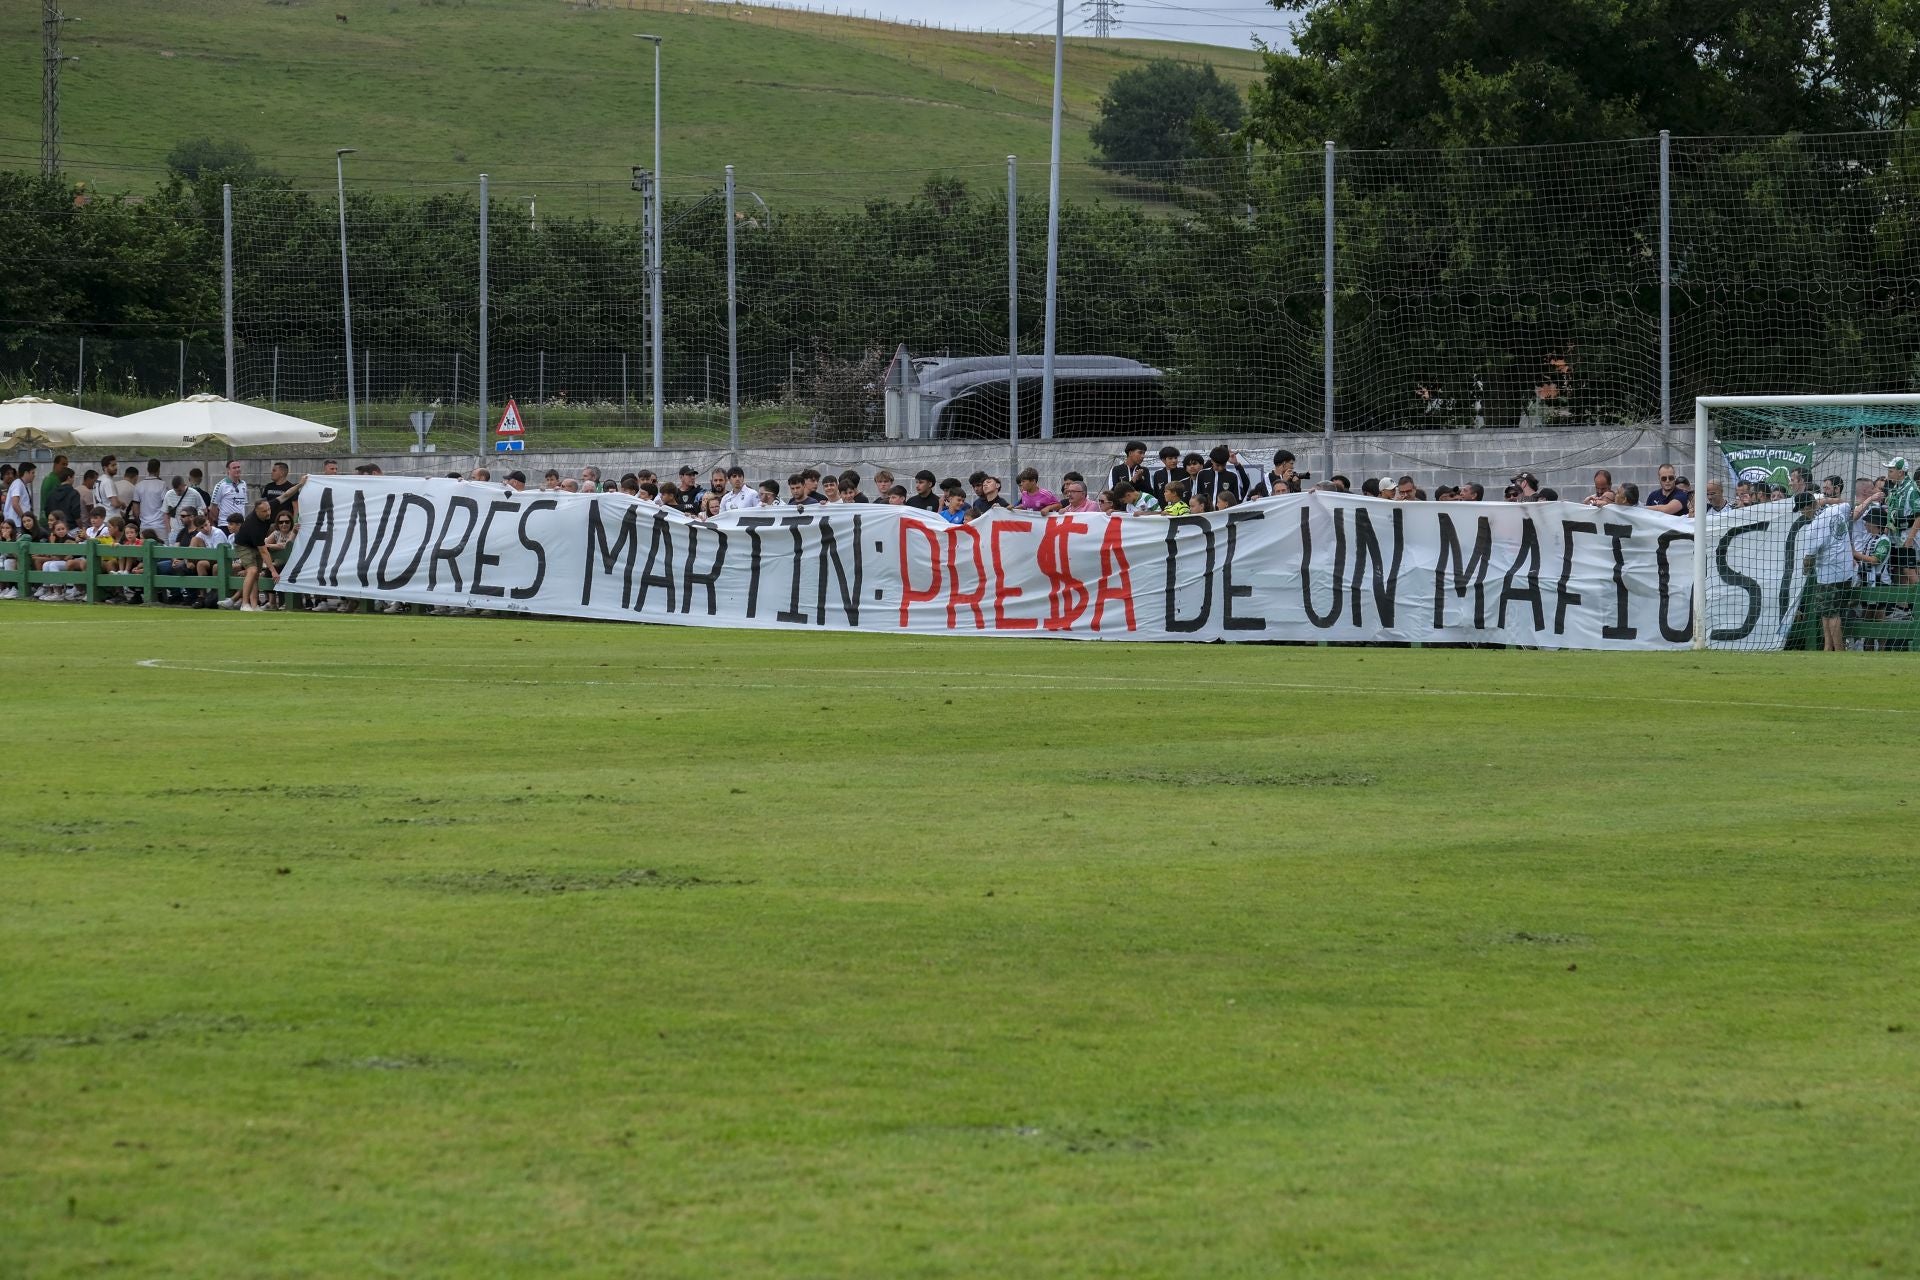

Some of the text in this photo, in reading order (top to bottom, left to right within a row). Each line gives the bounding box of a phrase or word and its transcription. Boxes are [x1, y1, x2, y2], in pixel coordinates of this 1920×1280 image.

[1727, 449, 1766, 462] OMANDO
[288, 487, 557, 600] ANDRÉS
[1164, 510, 1267, 633] DE
[1300, 506, 1404, 629] UN
